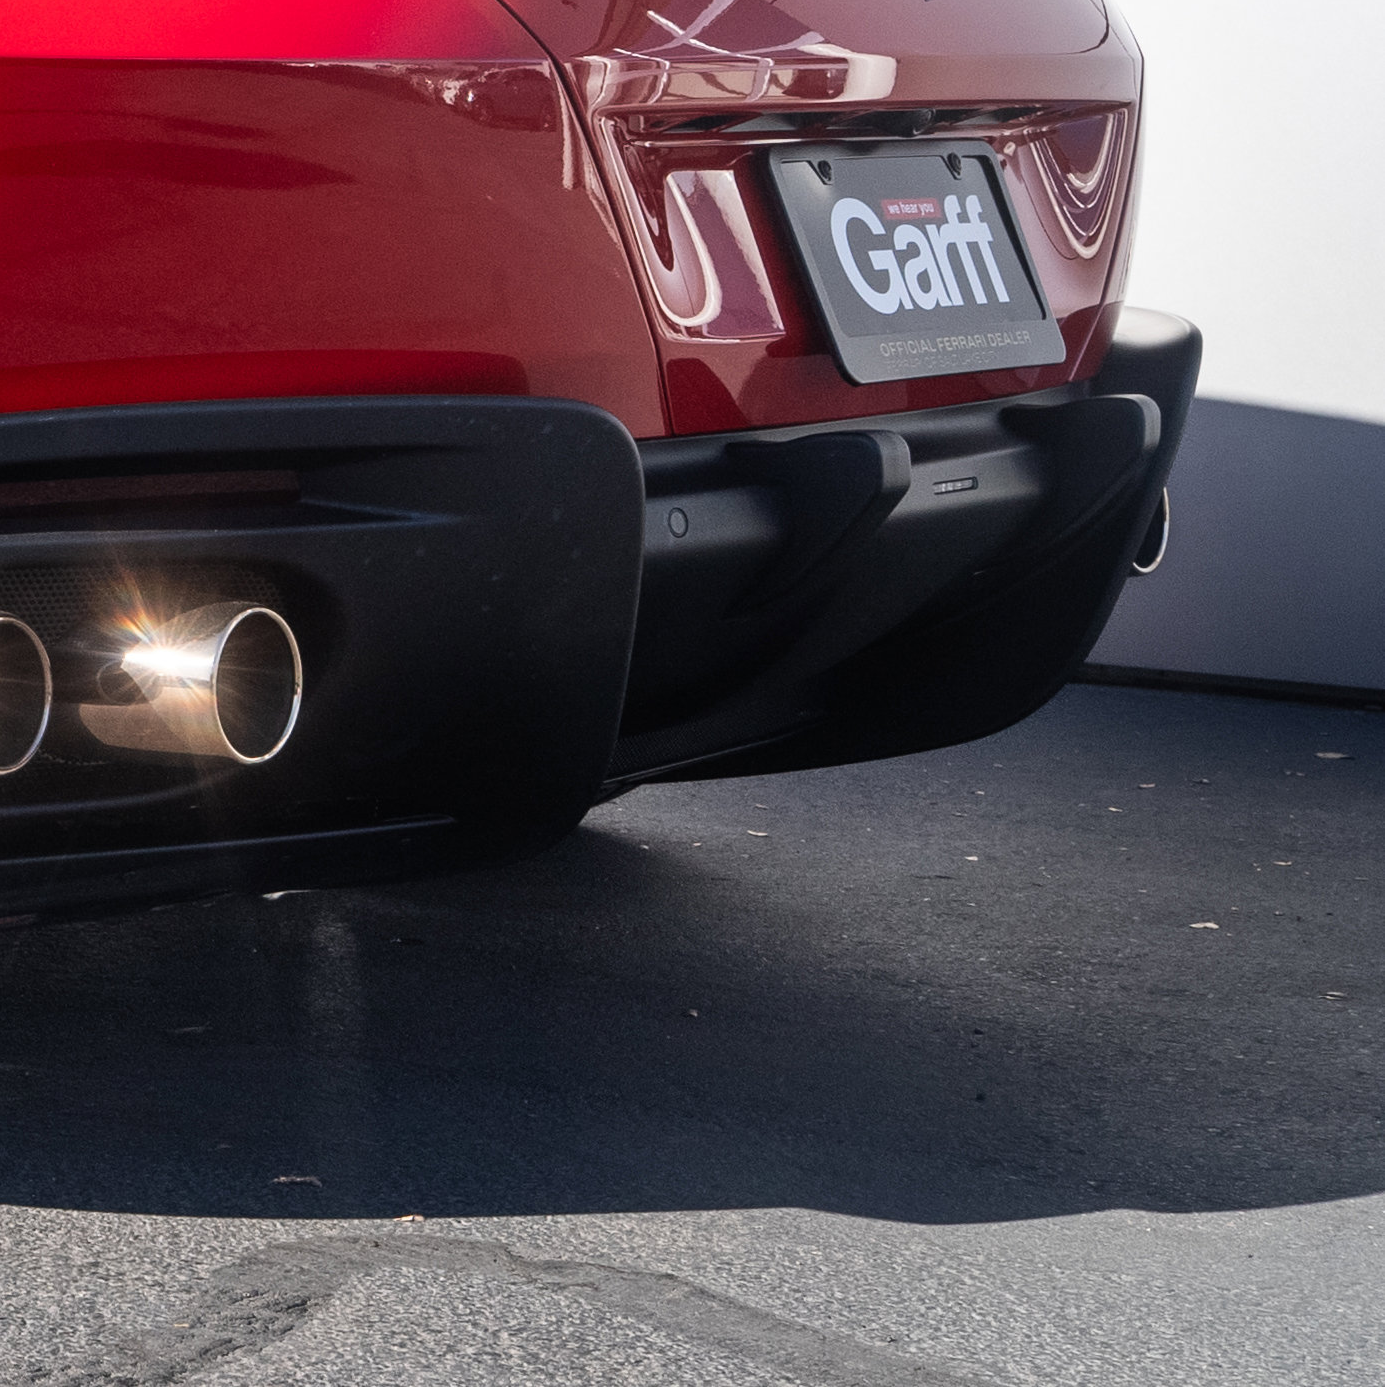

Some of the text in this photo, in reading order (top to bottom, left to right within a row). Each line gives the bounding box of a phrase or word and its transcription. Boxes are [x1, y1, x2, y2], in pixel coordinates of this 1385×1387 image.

[918, 202, 935, 216] you
[831, 195, 1010, 315] Garff
[879, 330, 1032, 357] OFFICIAL FERRARI DEALER
